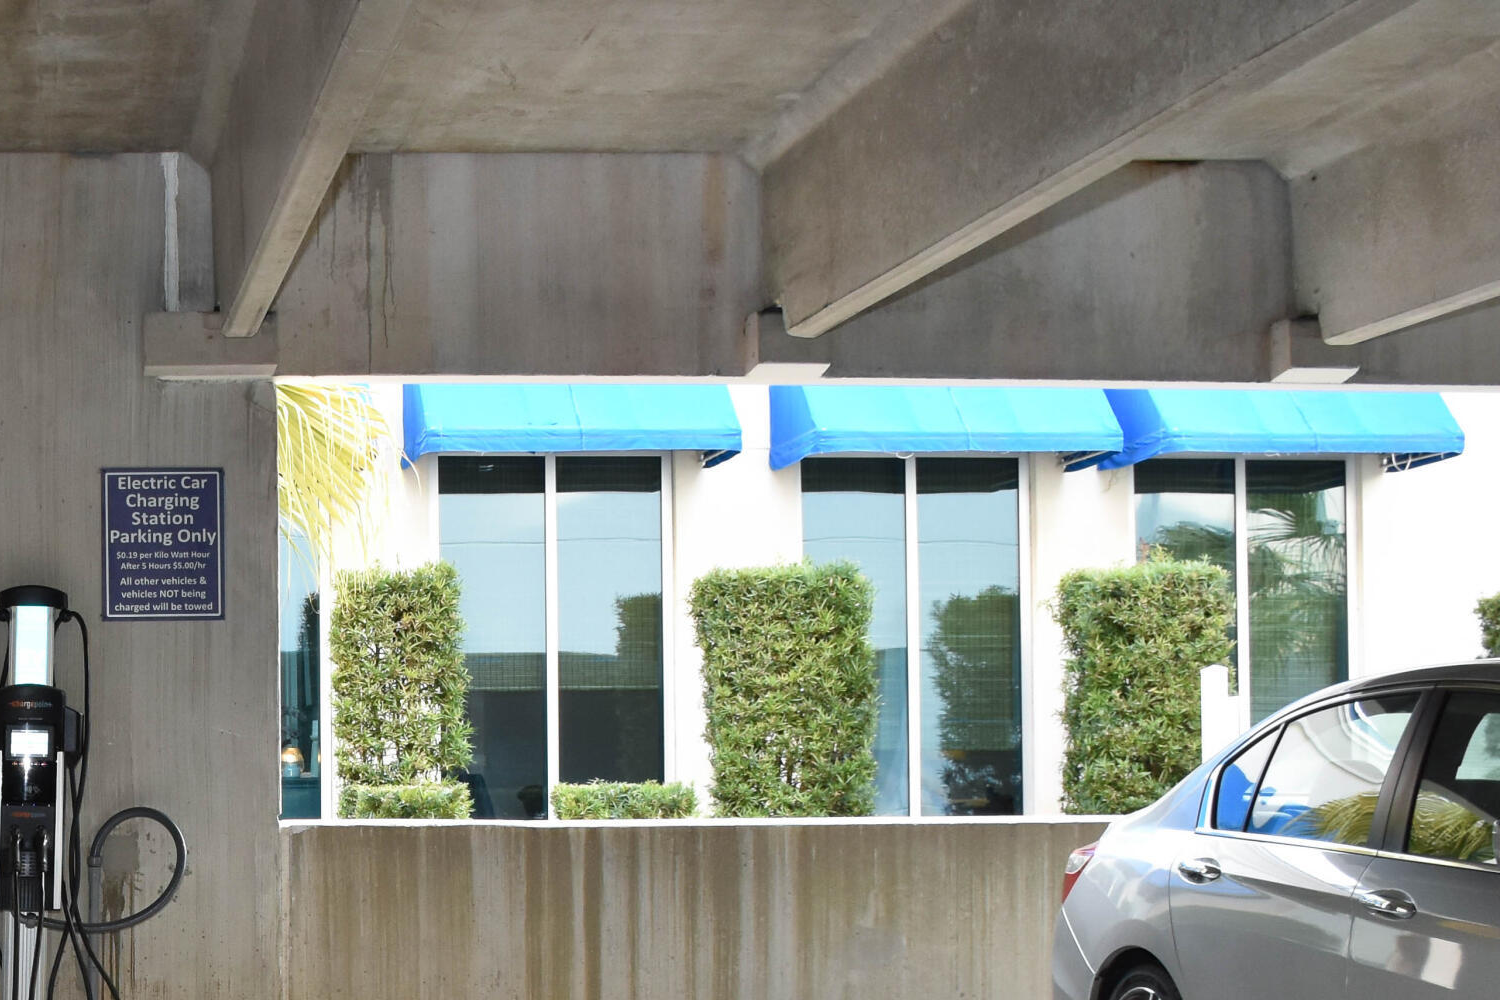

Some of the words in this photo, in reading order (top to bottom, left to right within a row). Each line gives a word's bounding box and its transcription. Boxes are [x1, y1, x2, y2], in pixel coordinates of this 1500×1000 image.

[117, 475, 177, 490] Electric
[180, 475, 208, 490] Car
[125, 492, 200, 511] Charging
[131, 510, 194, 526] Station
[110, 528, 173, 547] Parking
[177, 527, 217, 546] Only
[139, 552, 153, 561] per
[154, 551, 170, 560] Kilo
[170, 551, 189, 560] Watt
[190, 551, 210, 560] Hour
[120, 561, 141, 570] After
[141, 561, 147, 570] 5
[148, 561, 172, 570] Hours
[119, 576, 133, 586] All
[133, 576, 160, 586] other
[160, 576, 198, 586] vehicles
[199, 576, 207, 585] &
[121, 589, 158, 599] vehicles
[159, 589, 180, 599] NOT
[181, 588, 207, 600] being
[114, 601, 151, 613] charged
[152, 601, 169, 611] will
[170, 601, 183, 611] be
[184, 601, 213, 611] towed
